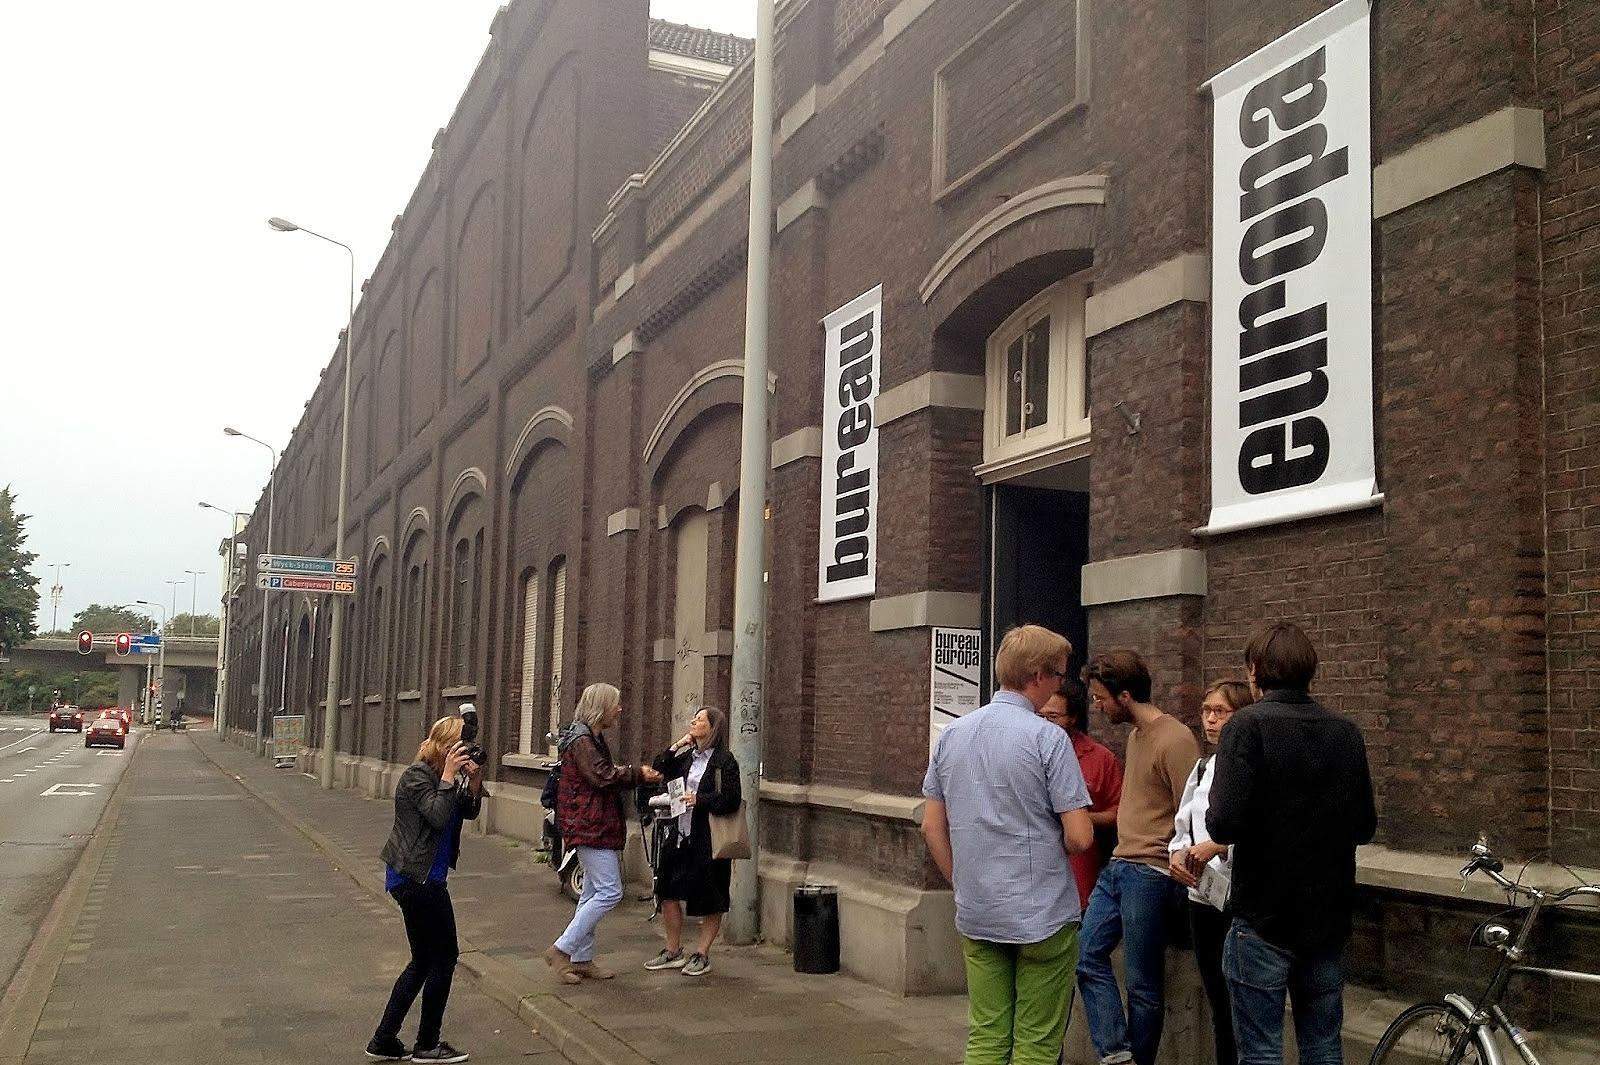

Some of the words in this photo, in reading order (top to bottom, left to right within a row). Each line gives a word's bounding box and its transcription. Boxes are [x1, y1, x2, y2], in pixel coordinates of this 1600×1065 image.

[1238, 45, 1349, 495] europa
[826, 310, 874, 583] bureau
[335, 563, 353, 573] 295
[271, 578, 280, 587] P
[283, 579, 331, 590] Cabergerweg
[335, 581, 352, 591] 605
[935, 629, 980, 650] bureau
[935, 648, 980, 669] europa
